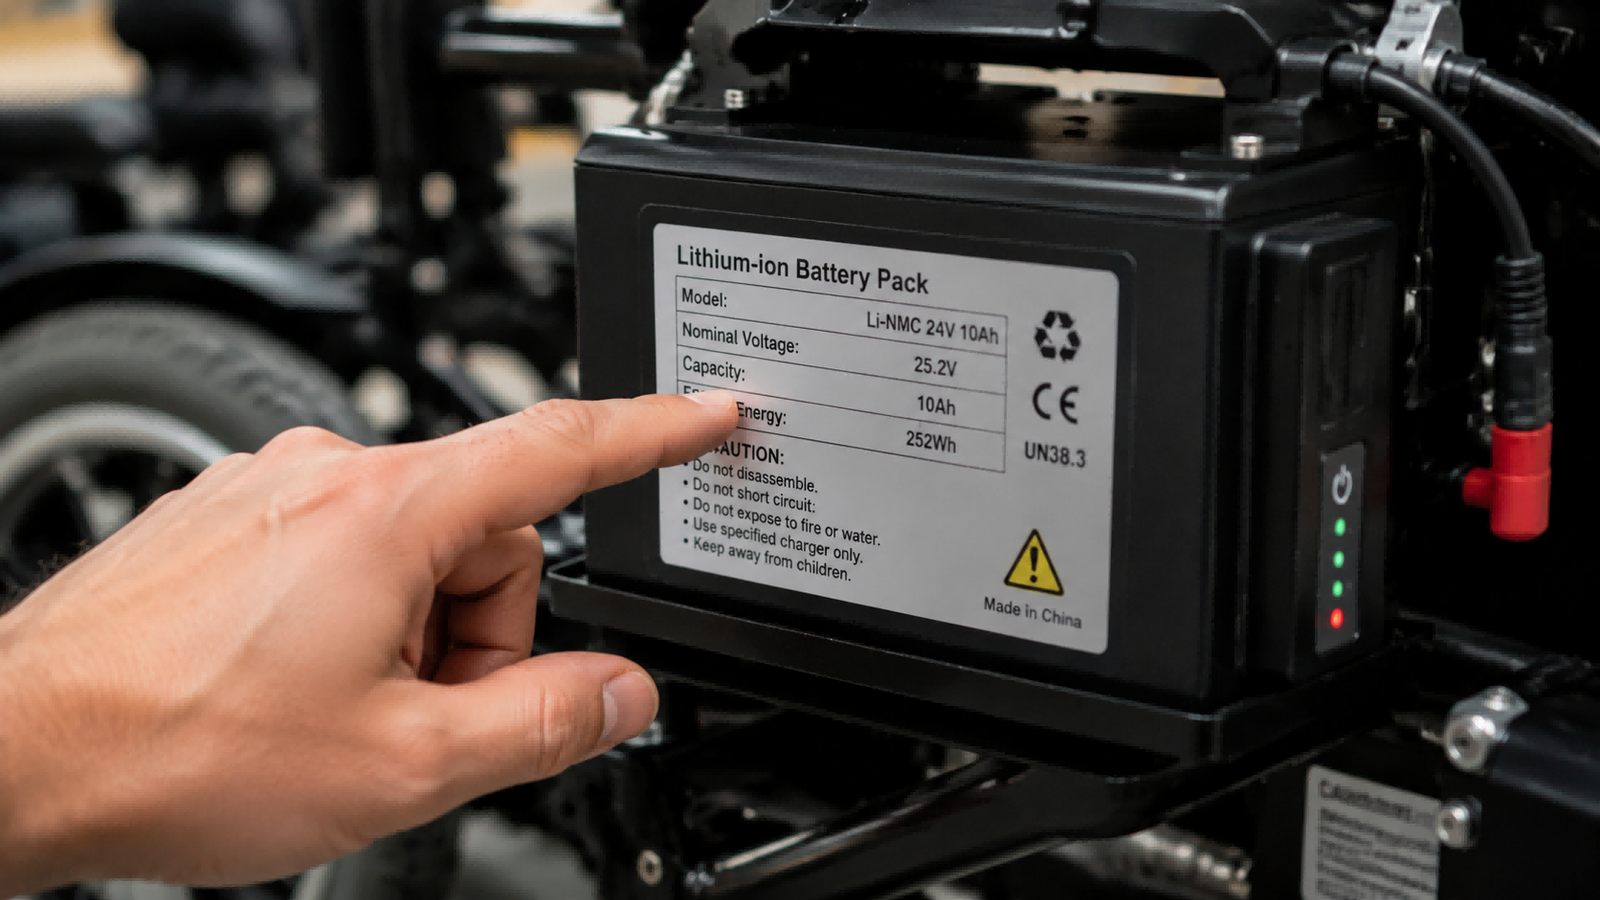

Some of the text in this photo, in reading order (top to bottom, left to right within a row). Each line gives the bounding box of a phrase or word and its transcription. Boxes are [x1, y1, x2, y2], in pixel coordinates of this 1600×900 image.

[677, 245, 929, 295] Lithium-ion Battery Pack
[681, 288, 727, 308] Model:
[682, 322, 799, 355] Nominal Voltage:
[867, 311, 999, 345] Li-NMC 24V 10Ah
[683, 355, 745, 382] Capacity:
[914, 356, 957, 377] 25.2V
[736, 402, 786, 427] Energy:
[918, 395, 956, 416] 10Ah
[1033, 382, 1079, 424] CE
[715, 441, 784, 465] AUTION:
[906, 431, 956, 453] 252Wh
[1025, 441, 1086, 468] UN38.3
[693, 458, 818, 493] Do not disassemble.
[693, 477, 709, 492] Do
[714, 481, 733, 497] not
[737, 485, 769, 504] short
[693, 497, 880, 546] Do not expose to fire or water.
[693, 516, 863, 563] Use specified charger only.
[693, 536, 851, 581] Keep away from children.
[984, 597, 1081, 629] Made in China
